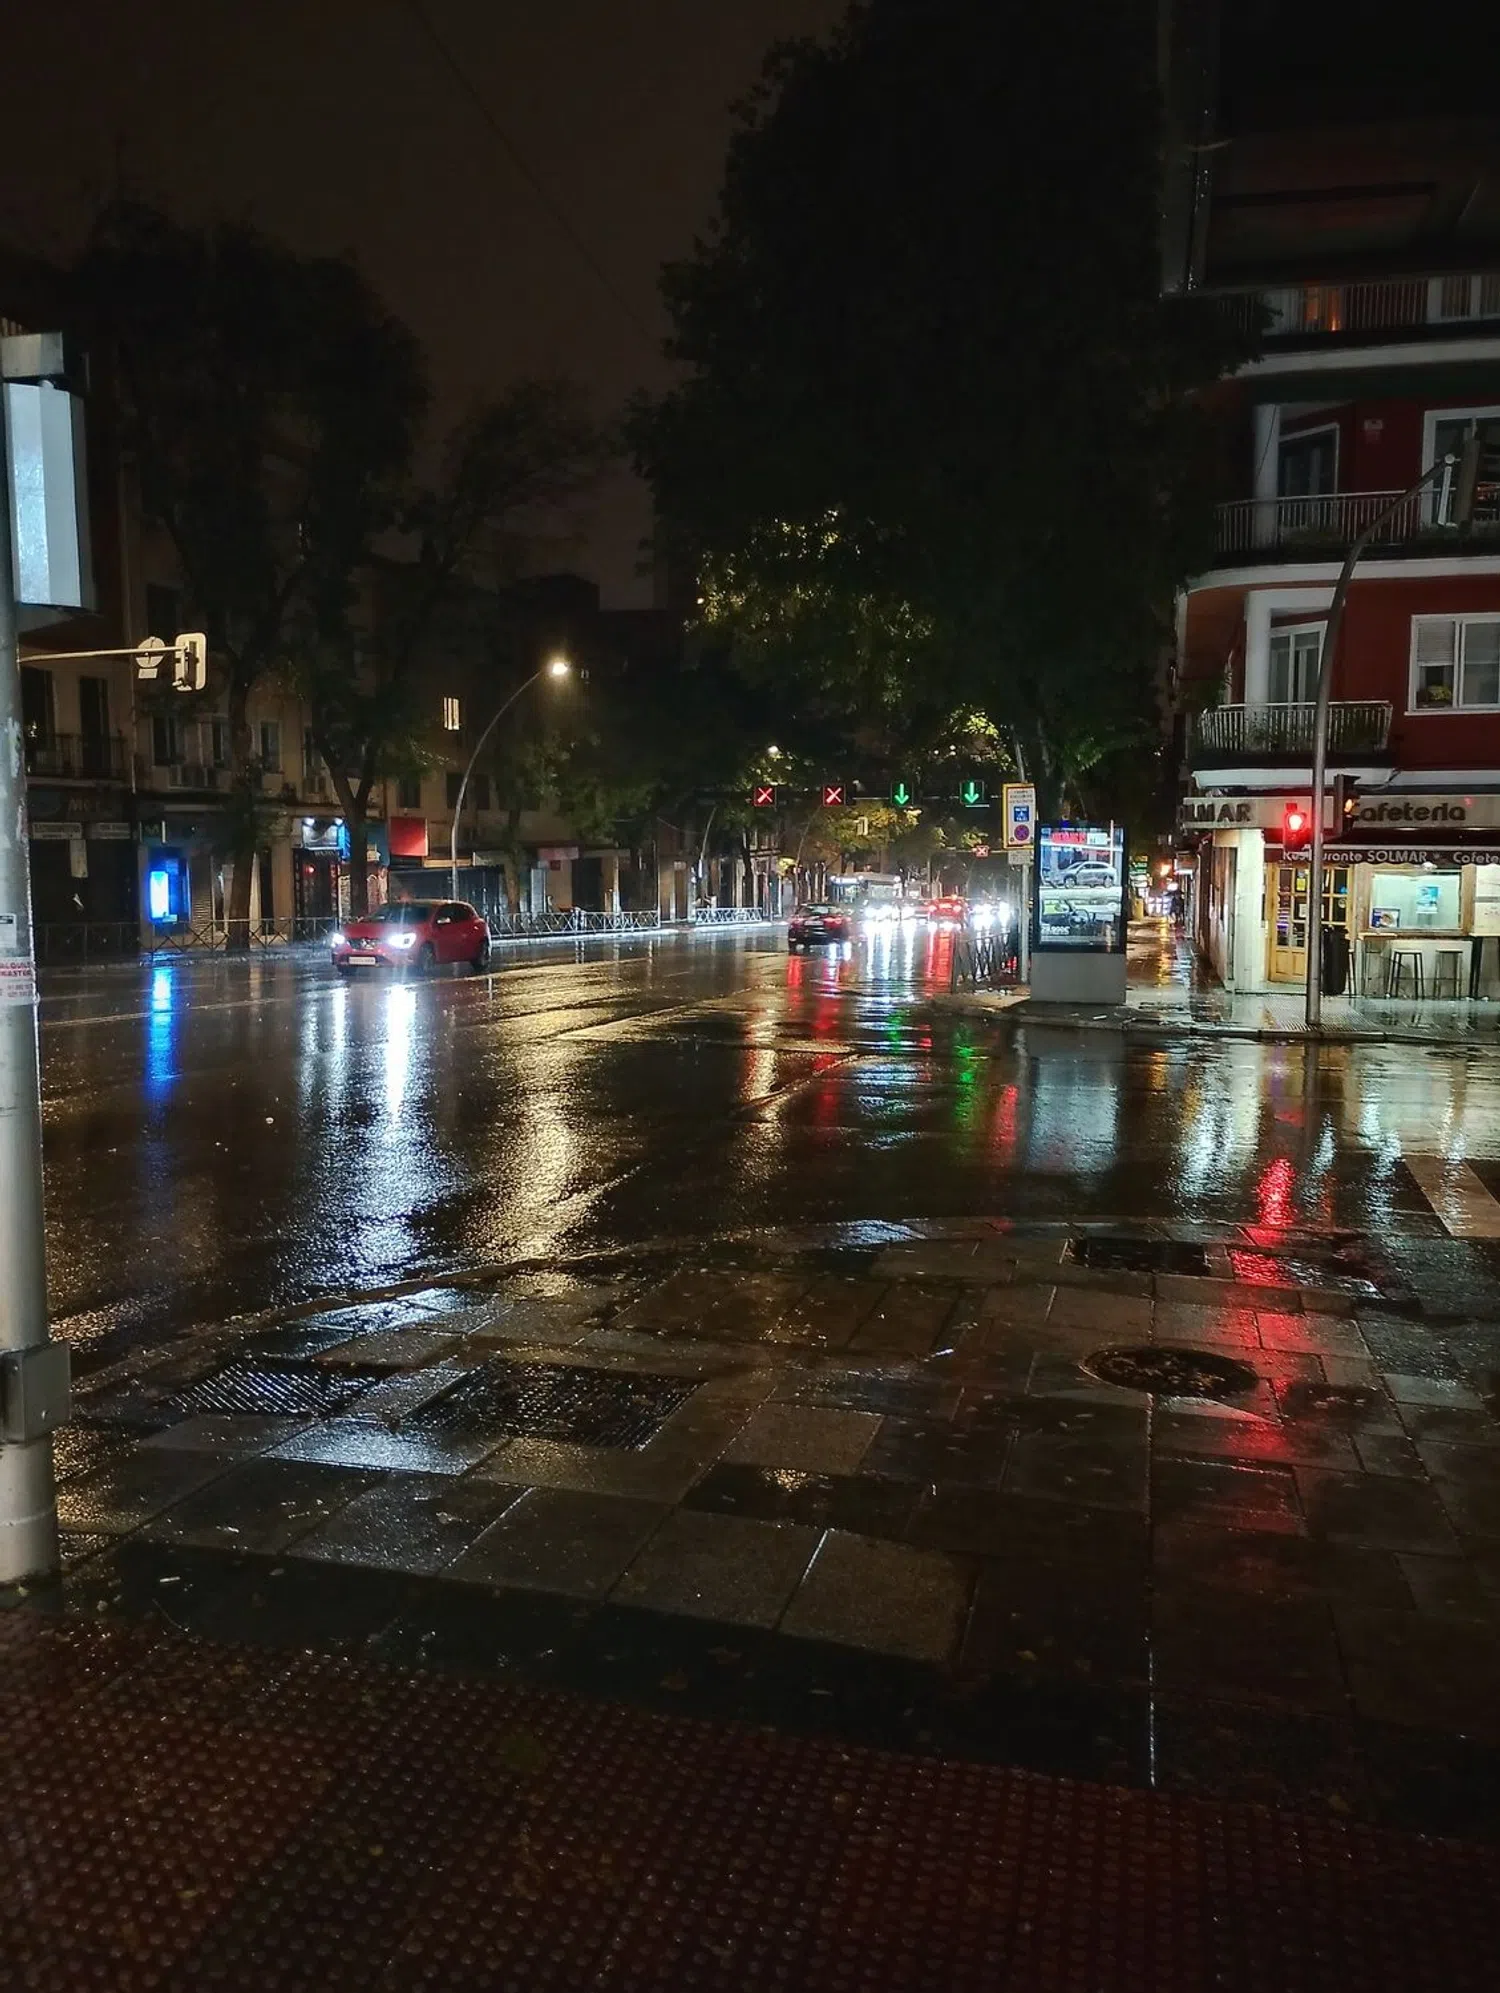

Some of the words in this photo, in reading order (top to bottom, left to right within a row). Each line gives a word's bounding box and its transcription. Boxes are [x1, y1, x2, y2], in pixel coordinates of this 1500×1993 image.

[1180, 803, 1251, 822] LMAR
[1367, 850, 1427, 863] SOLMAR
[1453, 851, 1500, 864] Cafete
